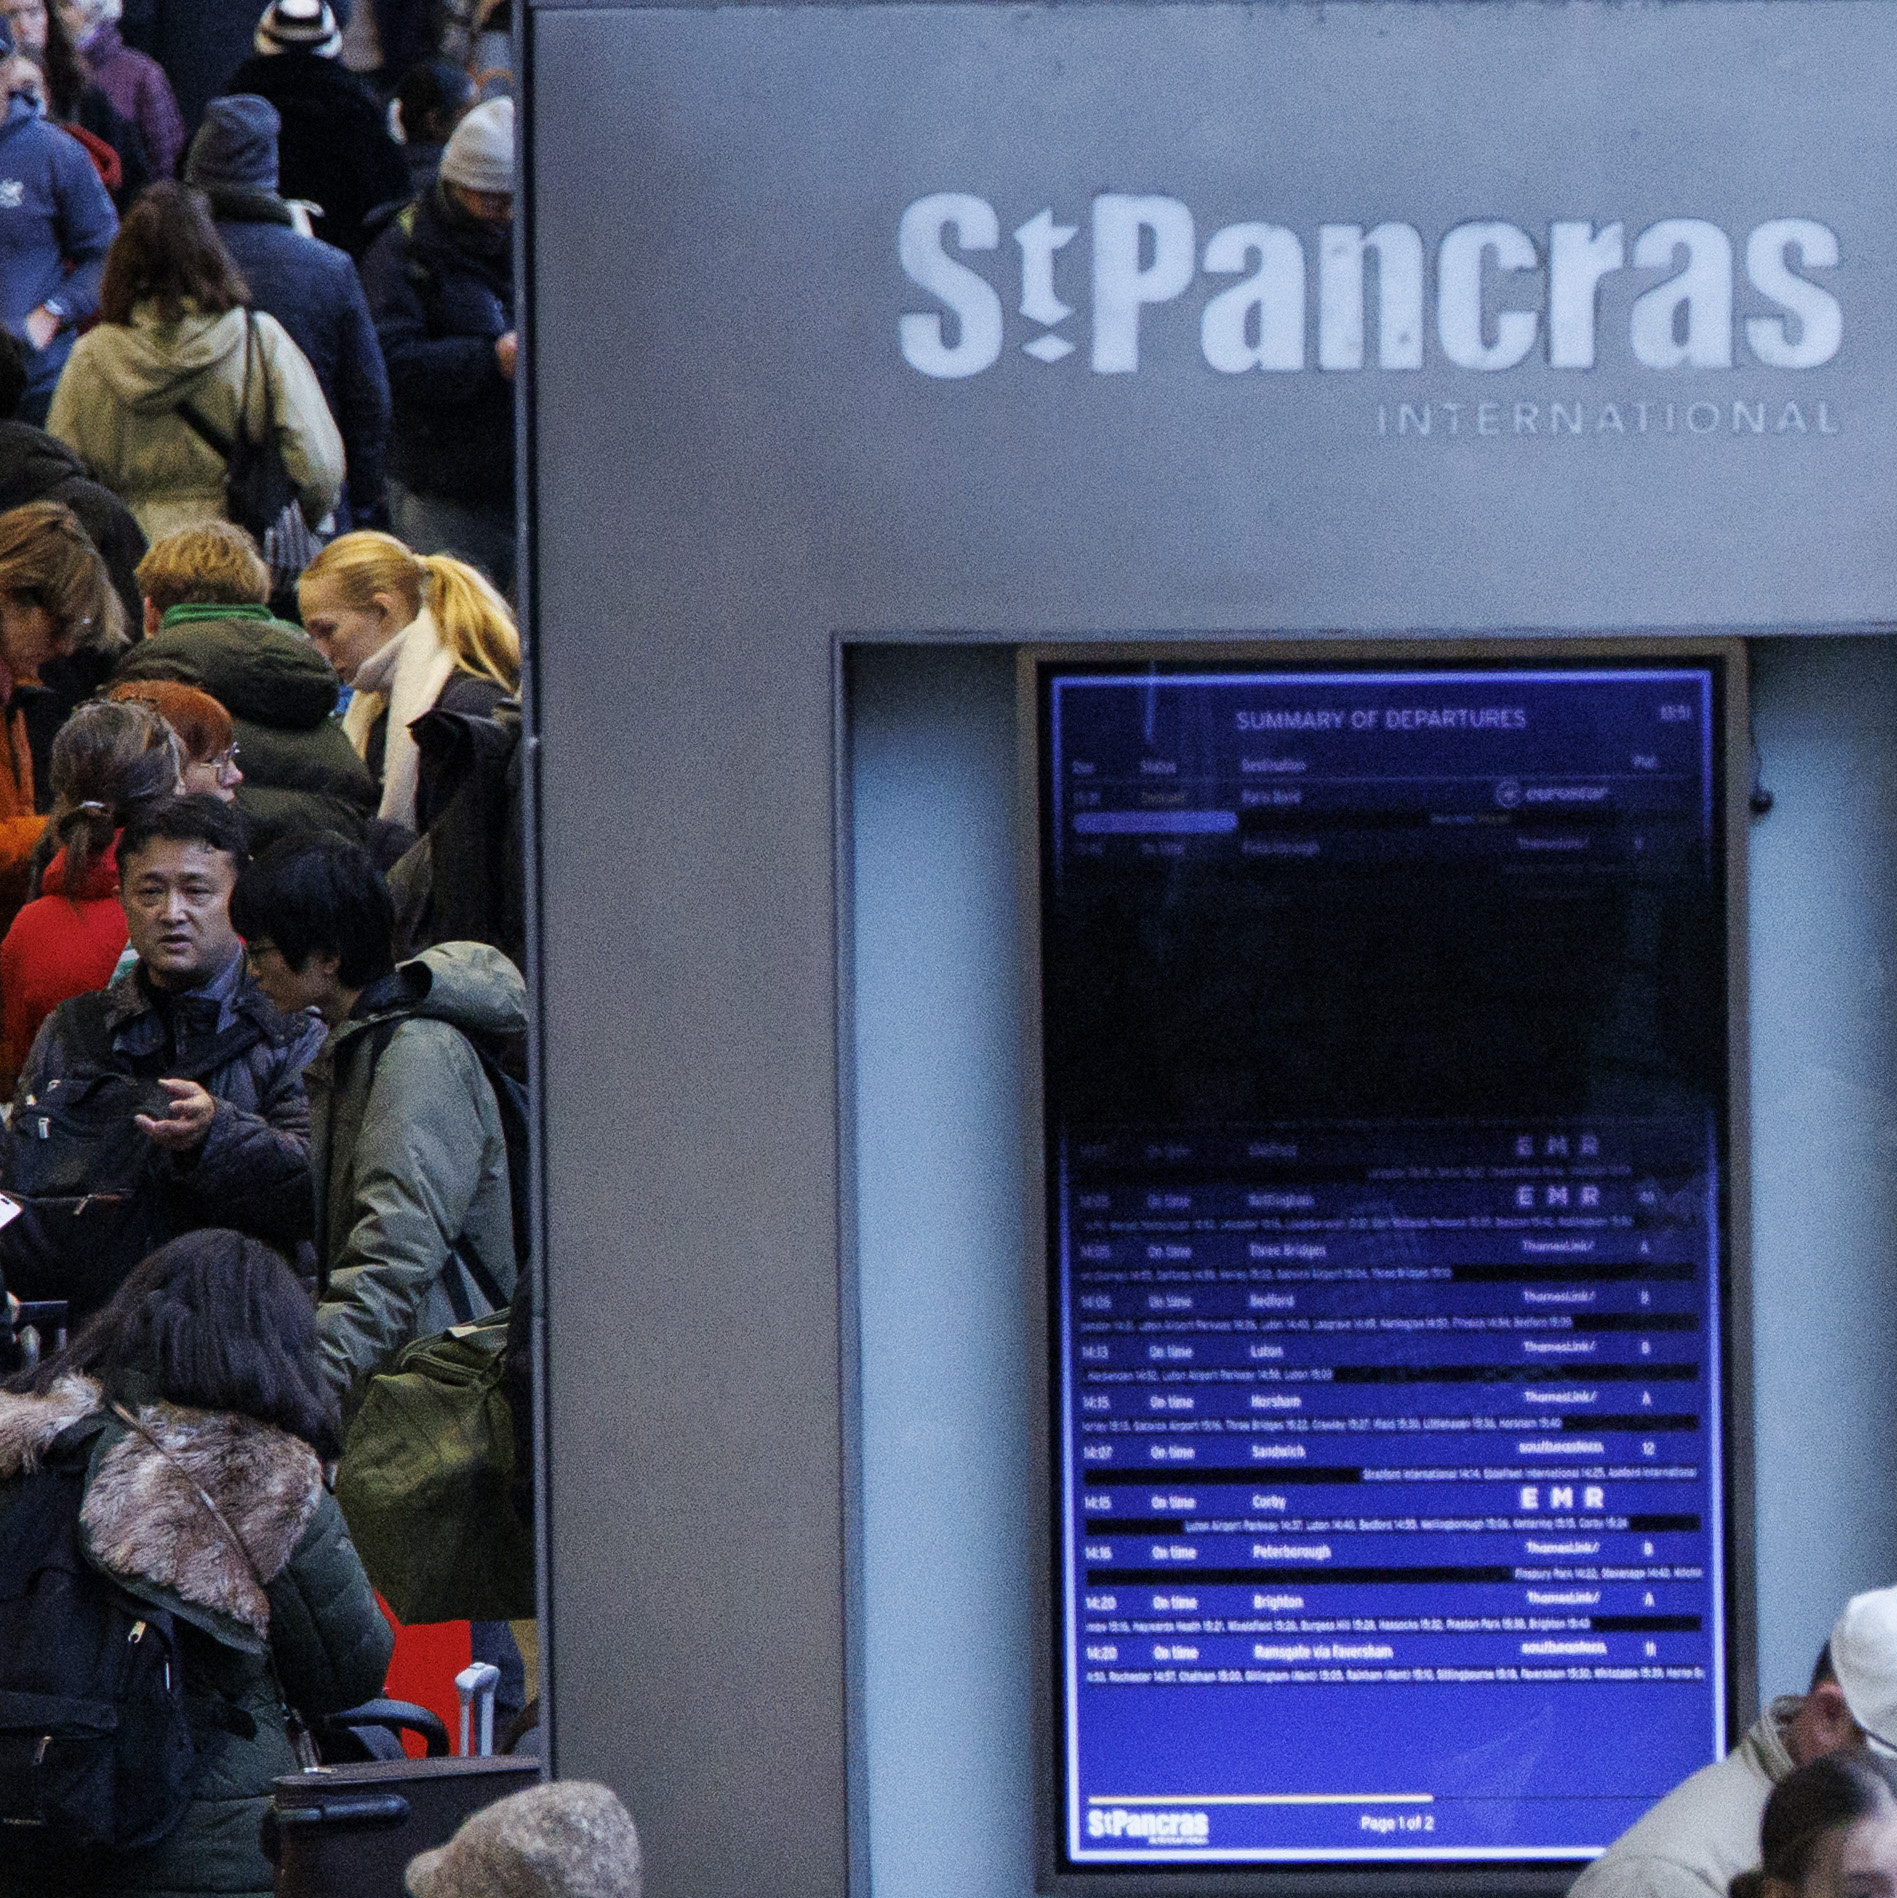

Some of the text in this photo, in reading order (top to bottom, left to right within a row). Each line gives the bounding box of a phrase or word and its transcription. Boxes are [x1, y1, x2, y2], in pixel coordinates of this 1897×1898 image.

[1090, 192, 1843, 374] Pancras
[1376, 399, 1840, 438] INTERNATIONAL
[1236, 711, 1344, 729] SUMMARY
[1350, 710, 1378, 729] OF
[1386, 709, 1526, 728] DEPARTURES
[1250, 1346, 1283, 1358] Luton
[1251, 1396, 1301, 1408] Horsham
[1642, 1392, 1651, 1405] A
[1252, 1445, 1306, 1458] Sandwich
[1642, 1442, 1655, 1455] 12
[1252, 1495, 1286, 1509] Corby
[1253, 1545, 1331, 1559] Peterborough
[1086, 1596, 1117, 1610] 14:20
[1253, 1595, 1304, 1610] Brighton
[1644, 1593, 1654, 1606] A
[1087, 1646, 1118, 1660] 14:20
[1254, 1645, 1312, 1660] Ramsgate
[1312, 1646, 1331, 1659] via
[1331, 1645, 1393, 1659] Faversham
[1112, 1810, 1209, 1837] Pancras
[1360, 1815, 1394, 1832] Page
[1406, 1815, 1421, 1830] of
[1423, 1815, 1434, 1830] 2
